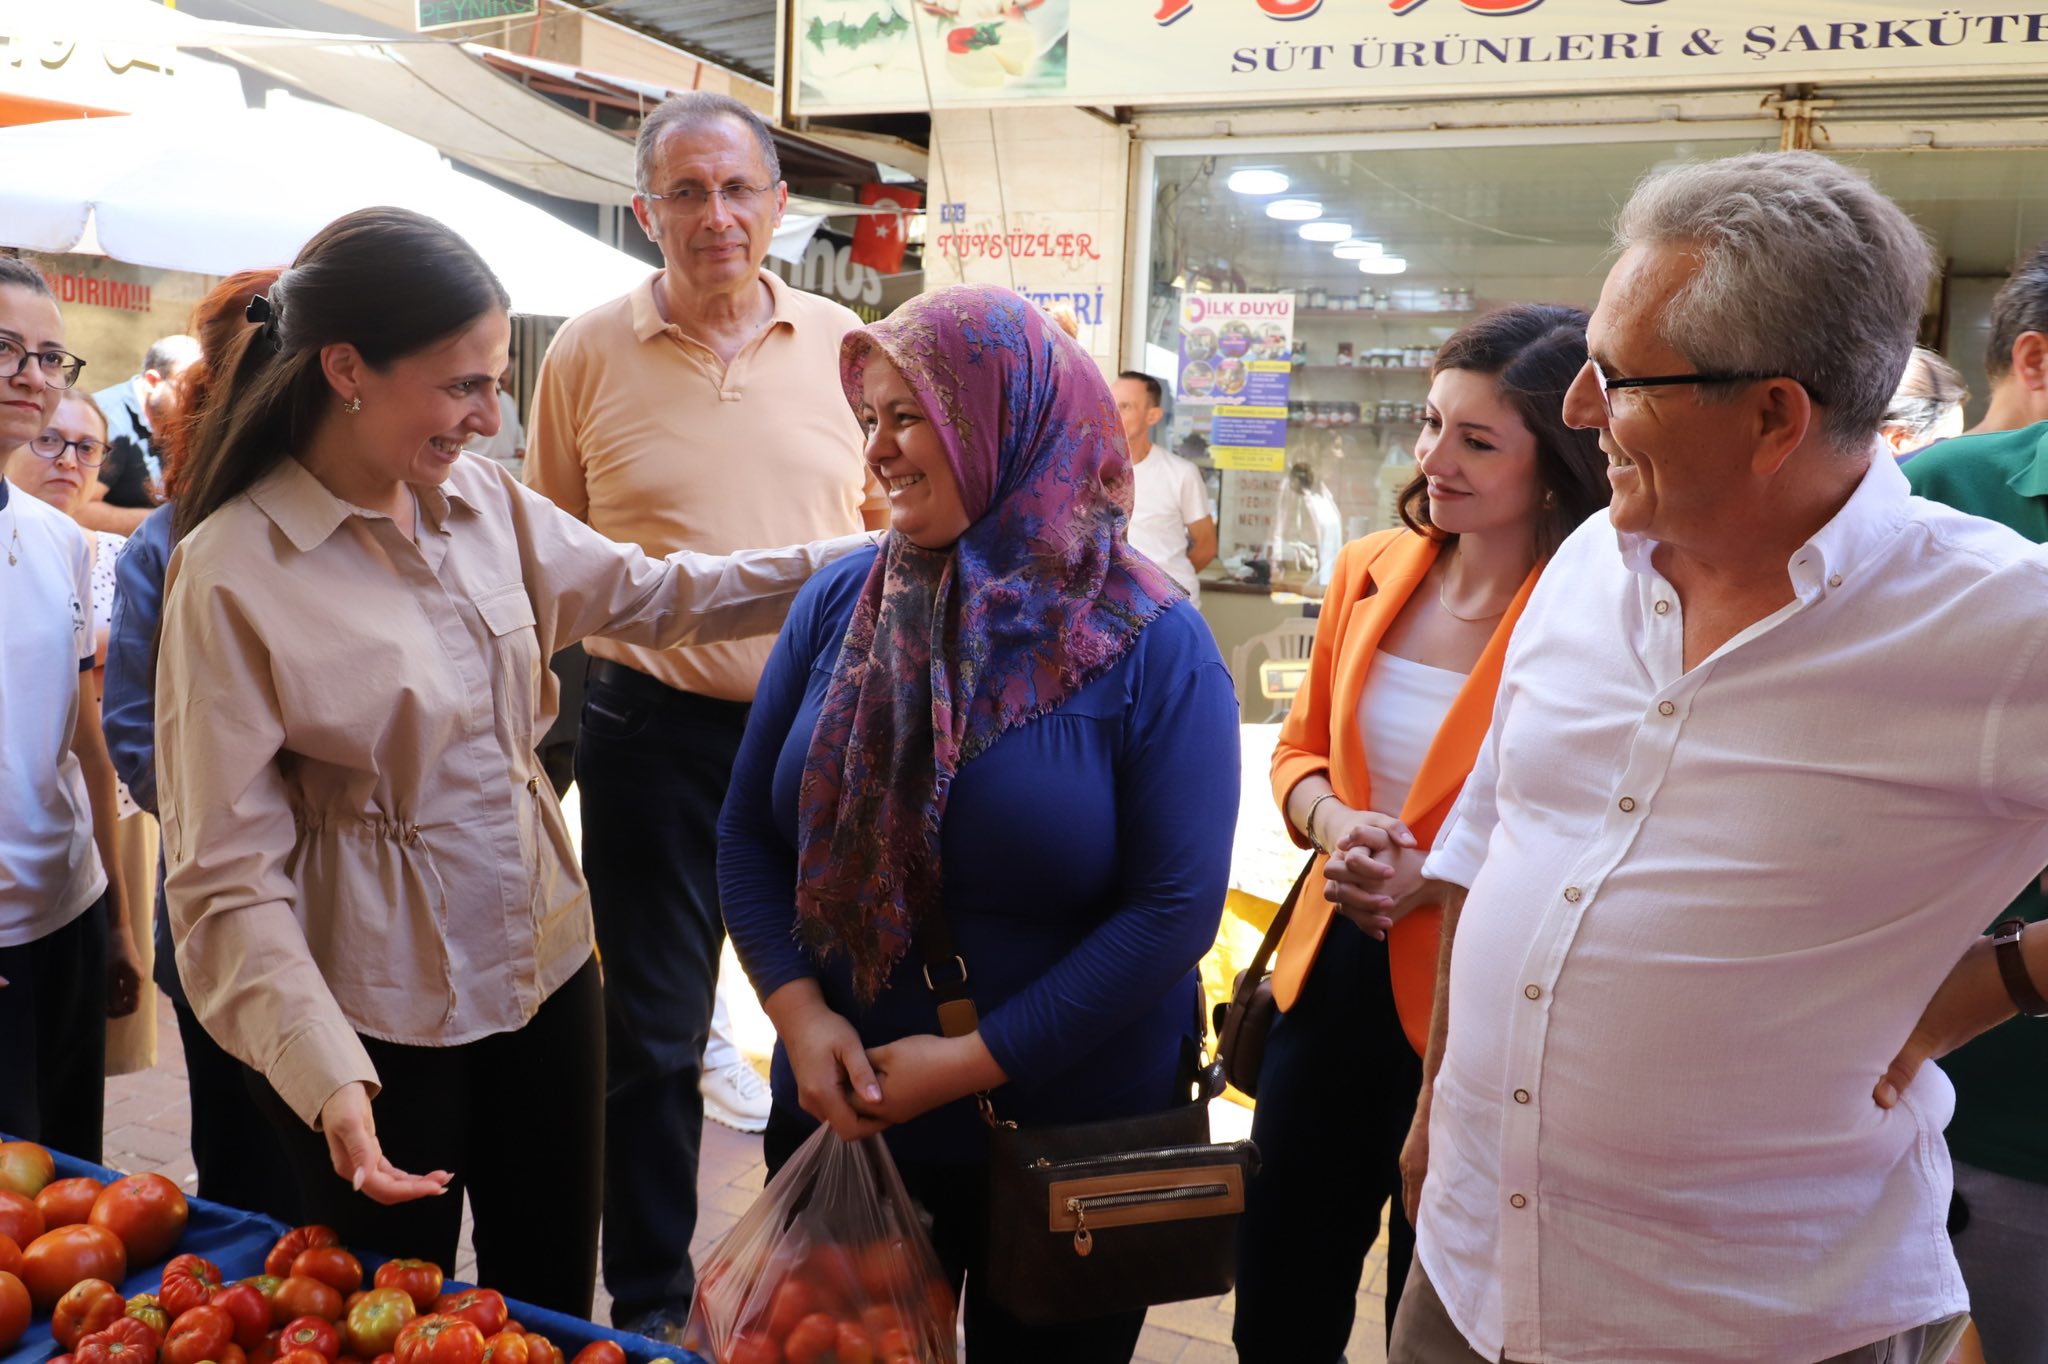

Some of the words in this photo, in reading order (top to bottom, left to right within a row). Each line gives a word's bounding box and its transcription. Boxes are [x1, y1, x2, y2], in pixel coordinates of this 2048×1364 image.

[1231, 40, 1334, 74] SÜT
[1350, 25, 1664, 69] ÜRÜNLERİ
[1682, 28, 1723, 57] &
[937, 228, 1101, 260] TÜYSÜZLER
